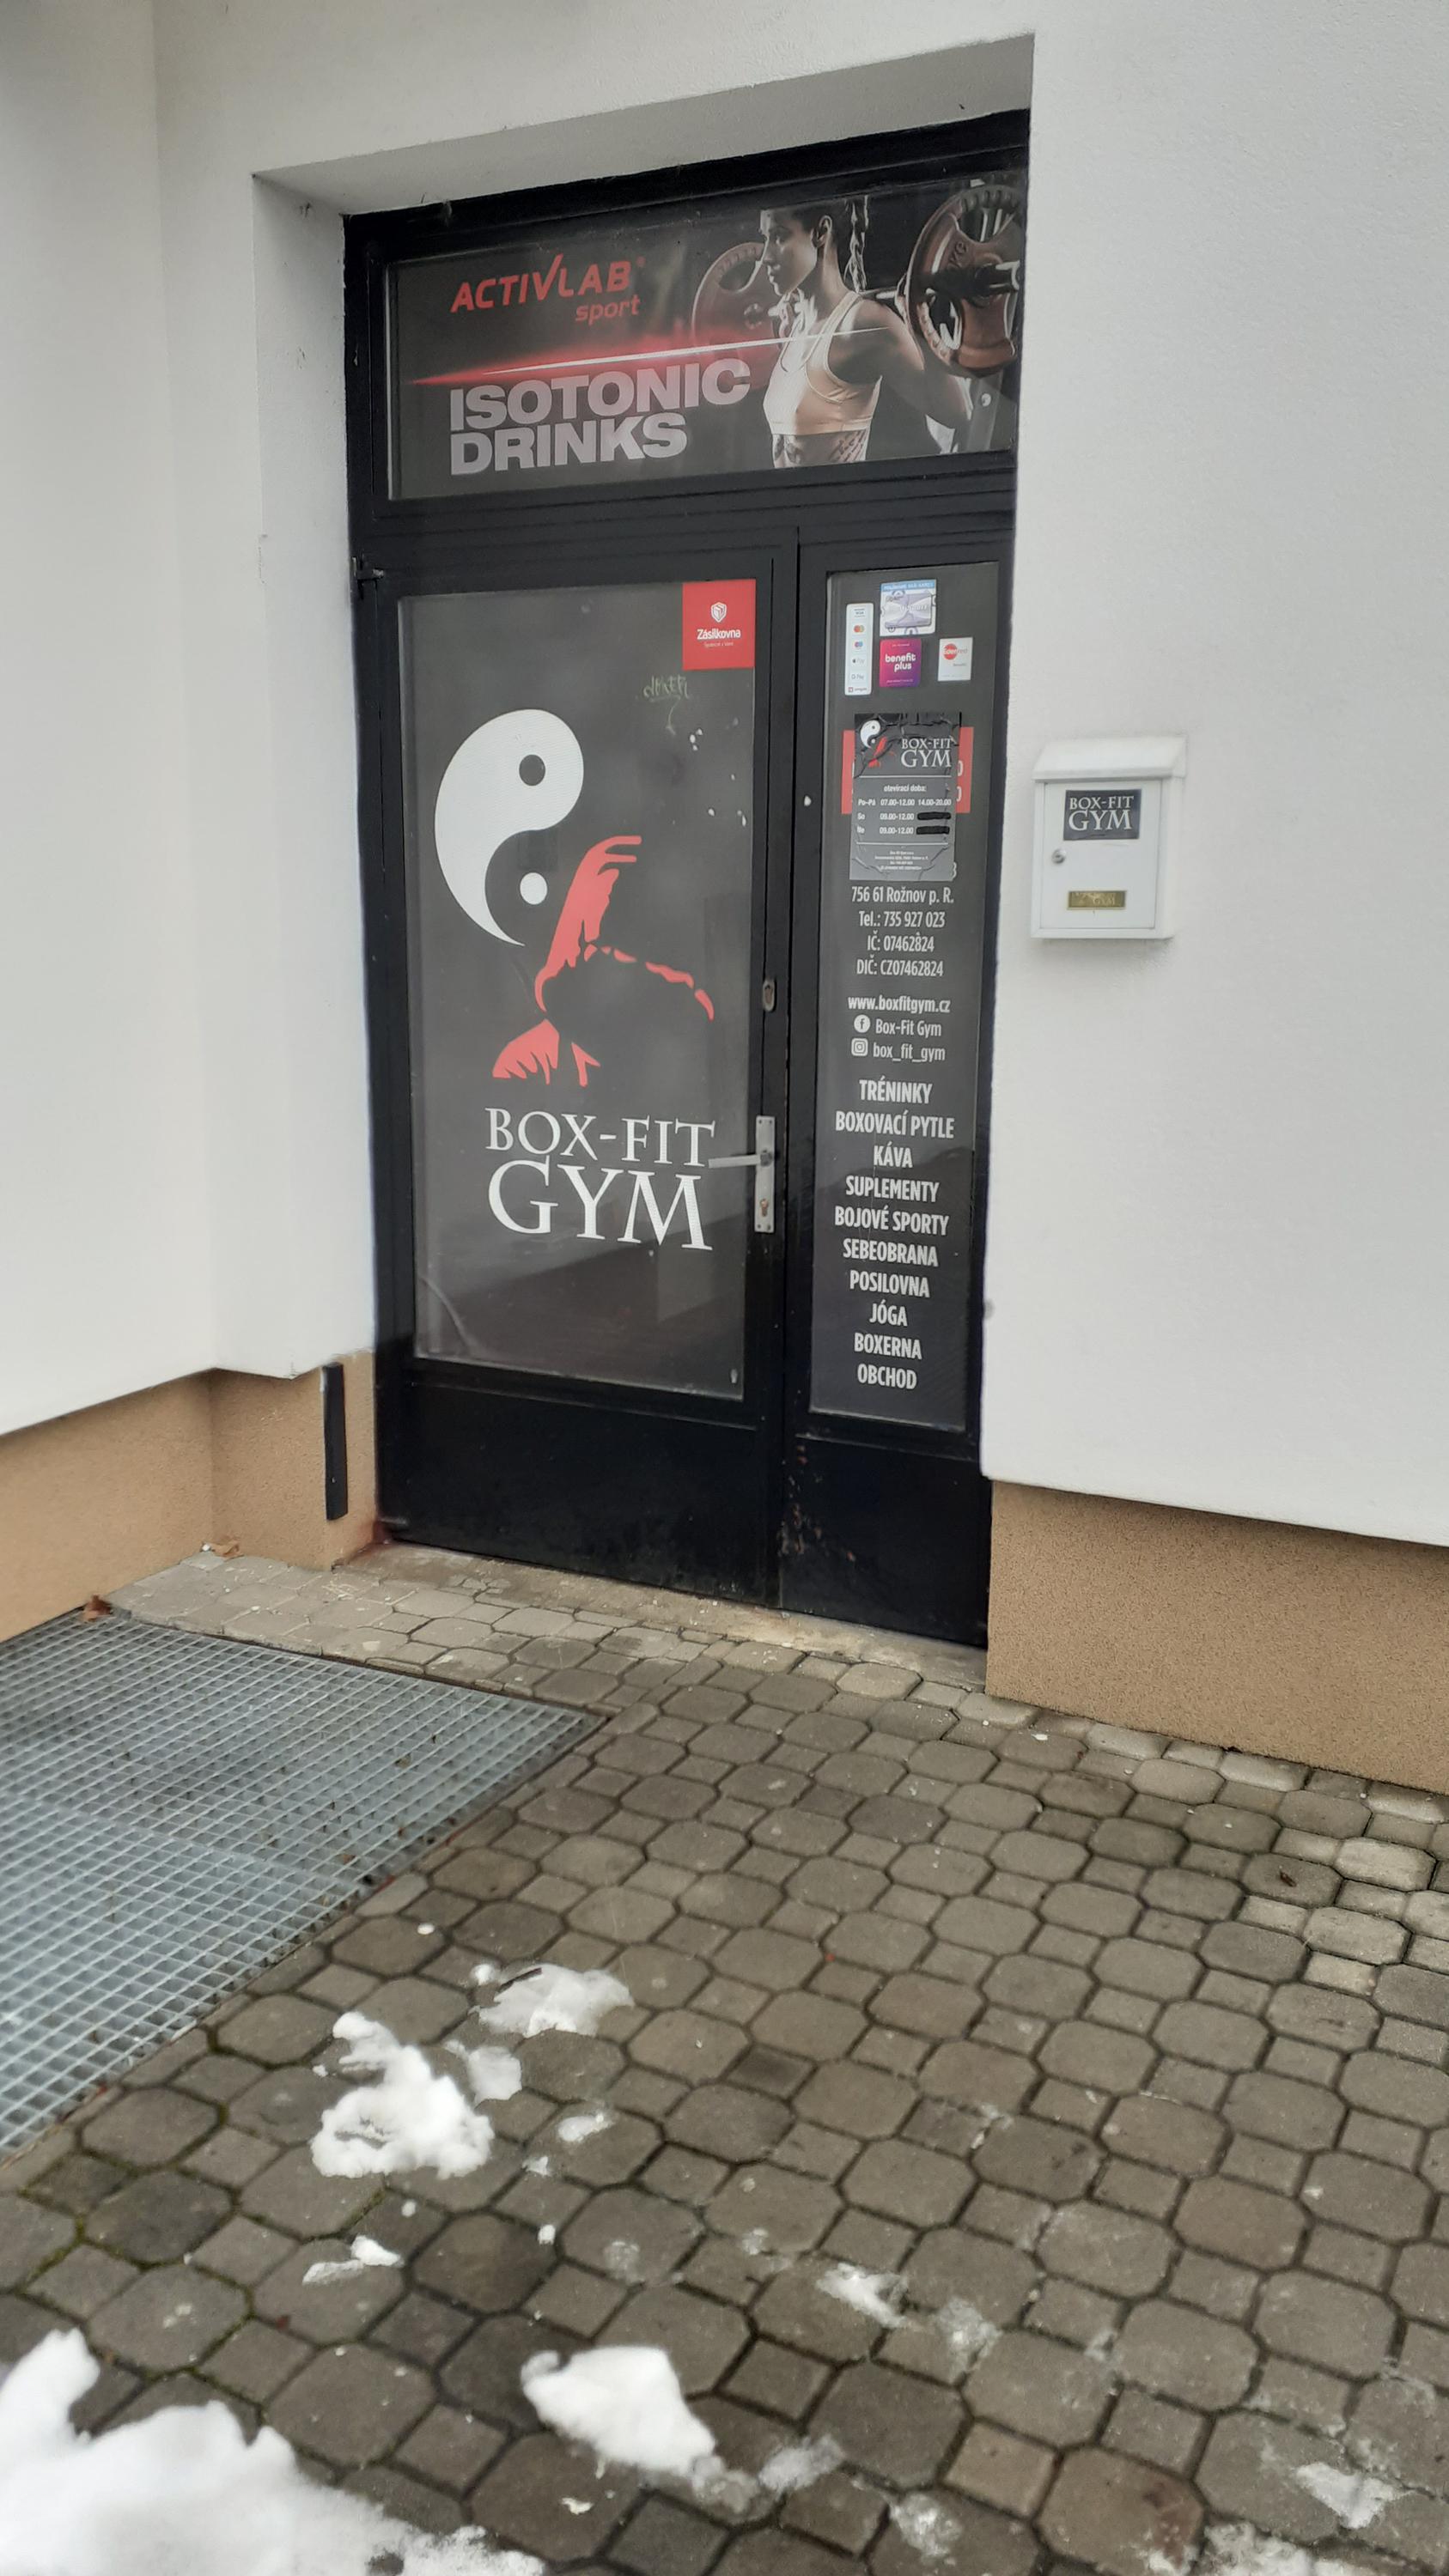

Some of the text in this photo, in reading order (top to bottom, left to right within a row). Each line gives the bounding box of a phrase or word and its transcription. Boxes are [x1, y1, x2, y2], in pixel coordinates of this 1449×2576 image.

[450, 253, 632, 313] ACTIVLAB
[575, 294, 641, 326] sport
[450, 358, 751, 431] ISOTONIC
[450, 412, 687, 475] DRINKS
[697, 628, 741, 641] Zásilkovna
[885, 653, 916, 663] benefit
[893, 661, 912, 673] plus
[902, 738, 953, 750] BOX-FIT
[900, 750, 953, 768] GYM
[1069, 795, 1134, 810] BOX-FIT
[1068, 809, 1133, 831] GYM
[851, 886, 954, 905] 756 61 Rožnov p. R.
[859, 911, 946, 927] Tel.: 735 927 023
[868, 930, 935, 952] IČ: 07462824
[856, 955, 944, 976] DIČ: CZ07462824
[848, 995, 951, 1014] www.boxfitgym.cz
[875, 1018, 942, 1038] Box-Fit Gym
[859, 1076, 933, 1104] TRÉNINKY
[484, 1108, 716, 1167] BOX-FIT
[835, 1110, 955, 1139] BOXOVACÍ PYTLE
[873, 1141, 913, 1168] KÁVA
[845, 1175, 940, 1203] SUPLEMENTY
[488, 1156, 713, 1250] GYM
[834, 1205, 949, 1236] BOJOVÉ SPORTY
[843, 1238, 939, 1267] SEBEOBRANA
[849, 1270, 930, 1297] POSILOVNA
[868, 1299, 908, 1327] JÓGA
[854, 1332, 922, 1360] BOXERNA
[857, 1363, 917, 1390] OBCHOD
